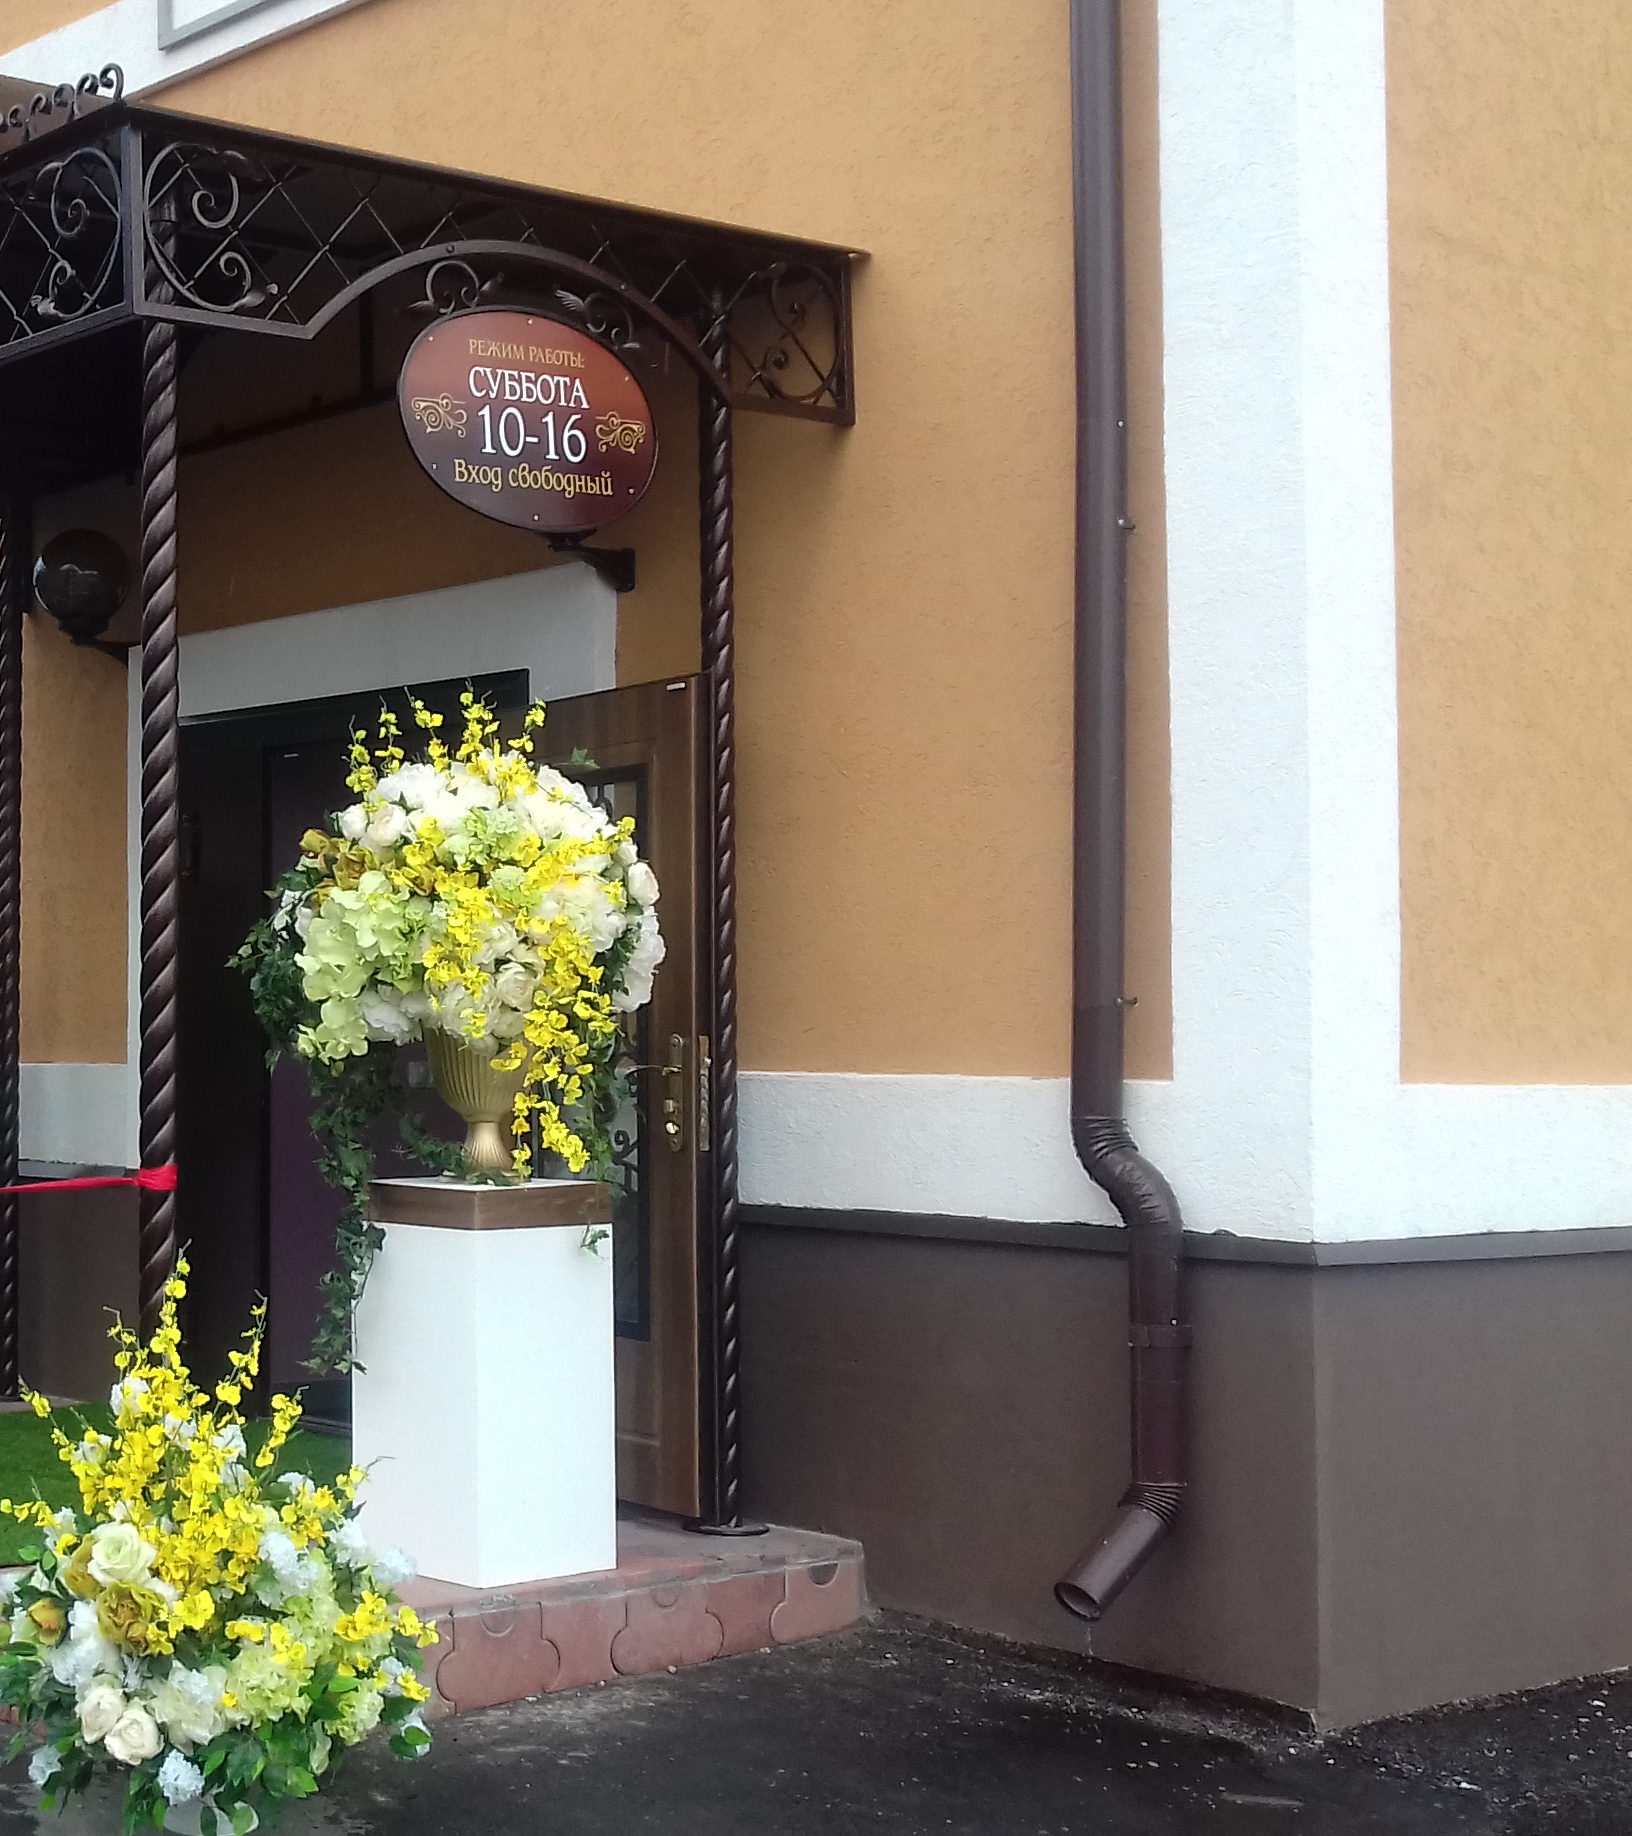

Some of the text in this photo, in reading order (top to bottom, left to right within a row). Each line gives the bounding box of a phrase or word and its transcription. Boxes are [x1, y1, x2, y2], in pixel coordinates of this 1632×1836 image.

[468, 340, 585, 368] РЕЖИМ РАБОТЫ:
[468, 367, 589, 408] СУББОТА
[477, 405, 586, 463] 10-16
[453, 459, 613, 498] Вход свободный
